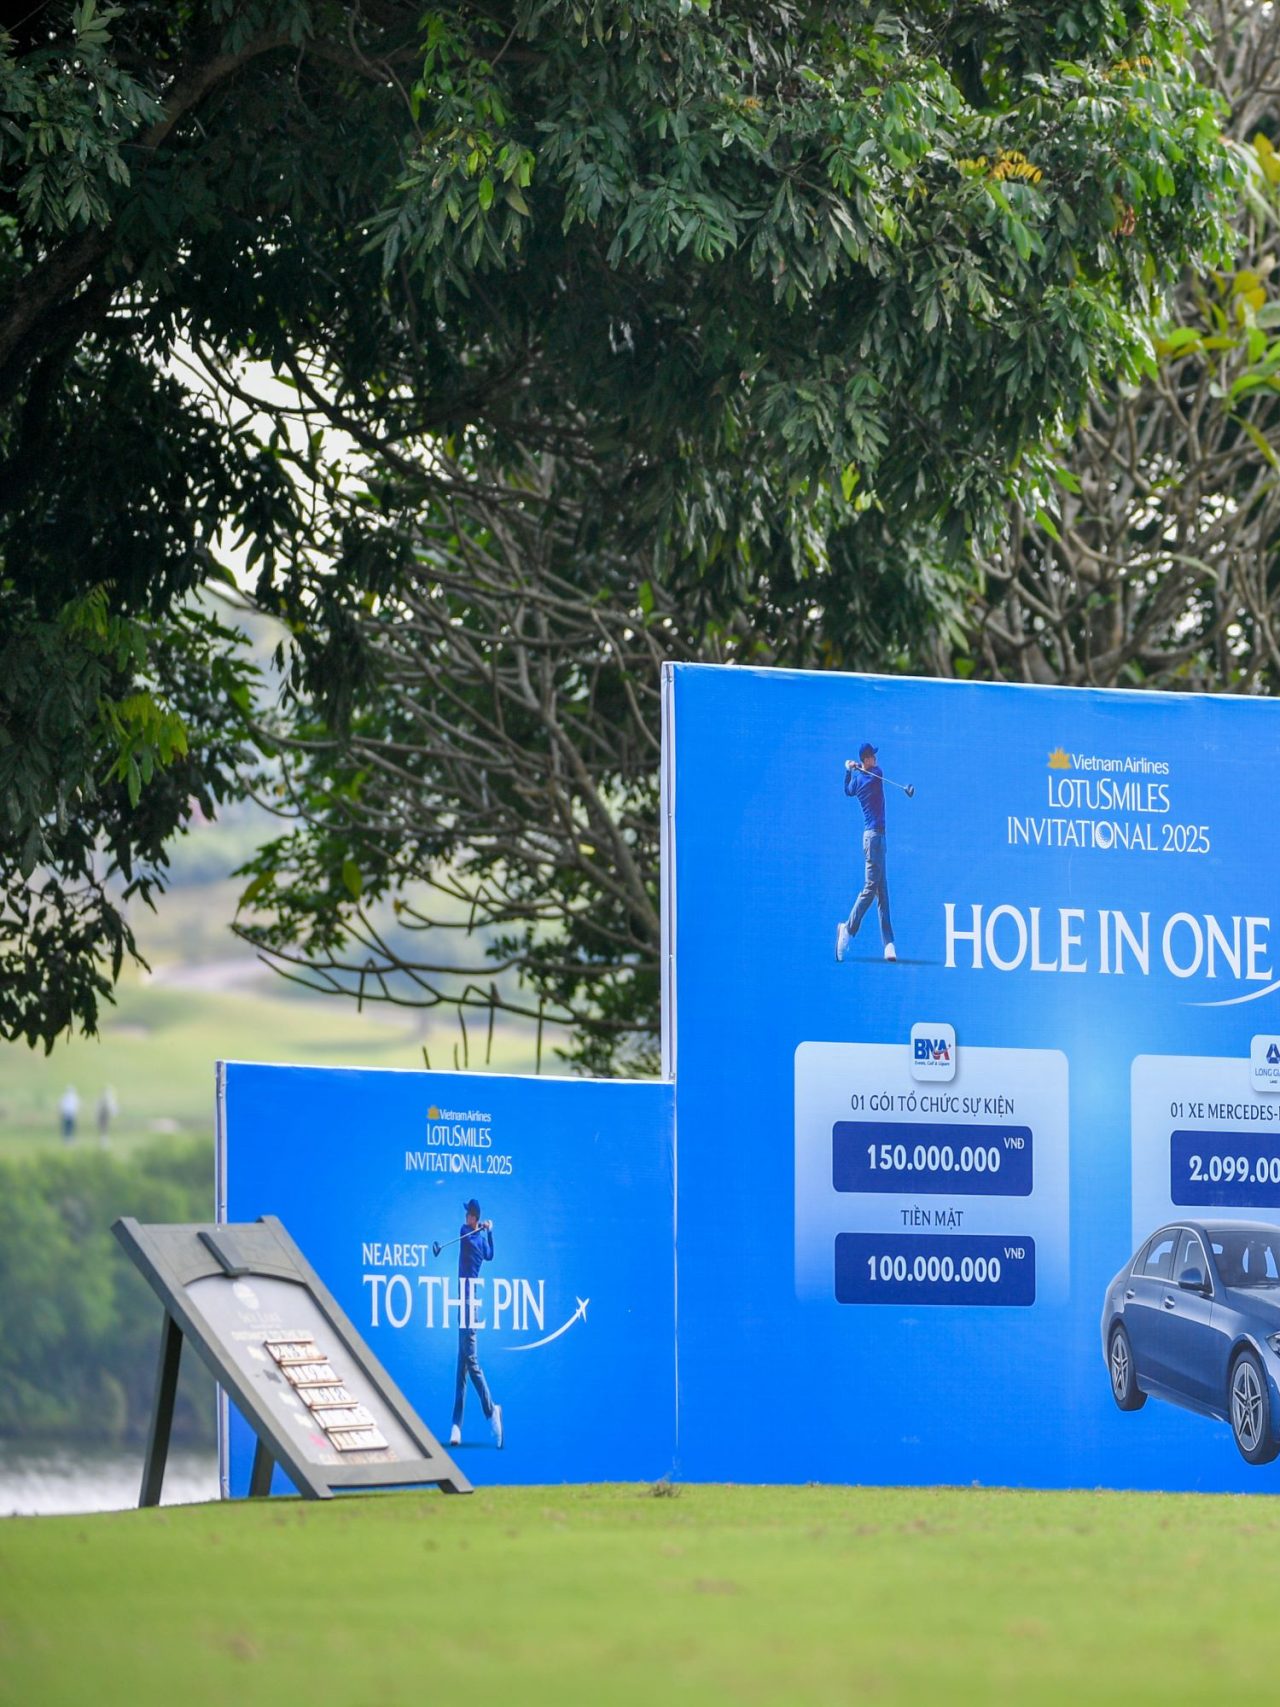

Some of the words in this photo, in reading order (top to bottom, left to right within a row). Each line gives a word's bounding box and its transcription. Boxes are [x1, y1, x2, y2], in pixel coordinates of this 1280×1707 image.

[1072, 753, 1123, 772] Vietnam
[1124, 756, 1169, 775] Airlines
[1007, 816, 1158, 852] INVITATIONAL
[1162, 825, 1210, 853] 2025
[944, 903, 1087, 973] HOLE
[1098, 909, 1150, 975] IN
[1162, 912, 1273, 980] ONE
[914, 1038, 951, 1061] BNA
[1254, 1067, 1273, 1077] LONG
[439, 1108, 467, 1121] Vietnam
[467, 1109, 492, 1123] Airlines
[850, 1094, 865, 1111] 01
[869, 1092, 894, 1112] GÓI
[898, 1090, 917, 1112] TỔ
[920, 1093, 960, 1114] CHỨC
[962, 1096, 982, 1117] SỰ
[984, 1095, 1014, 1118] KIỆN
[1170, 1102, 1184, 1118] 01
[1188, 1102, 1205, 1119] XE
[405, 1151, 485, 1174] INVITATIONAL
[487, 1154, 513, 1175] 2025
[867, 1143, 1001, 1173] 150.000.000
[1003, 1137, 1025, 1150] VNĐ
[901, 1204, 931, 1226] TIỀN
[935, 1207, 964, 1230] MẶT
[362, 1242, 428, 1267] NEAREST
[867, 1255, 1001, 1283] 100.000.000
[1004, 1247, 1025, 1260] VNĐ
[362, 1273, 413, 1329] TO
[418, 1275, 486, 1330] THE
[492, 1277, 545, 1331] PIN
